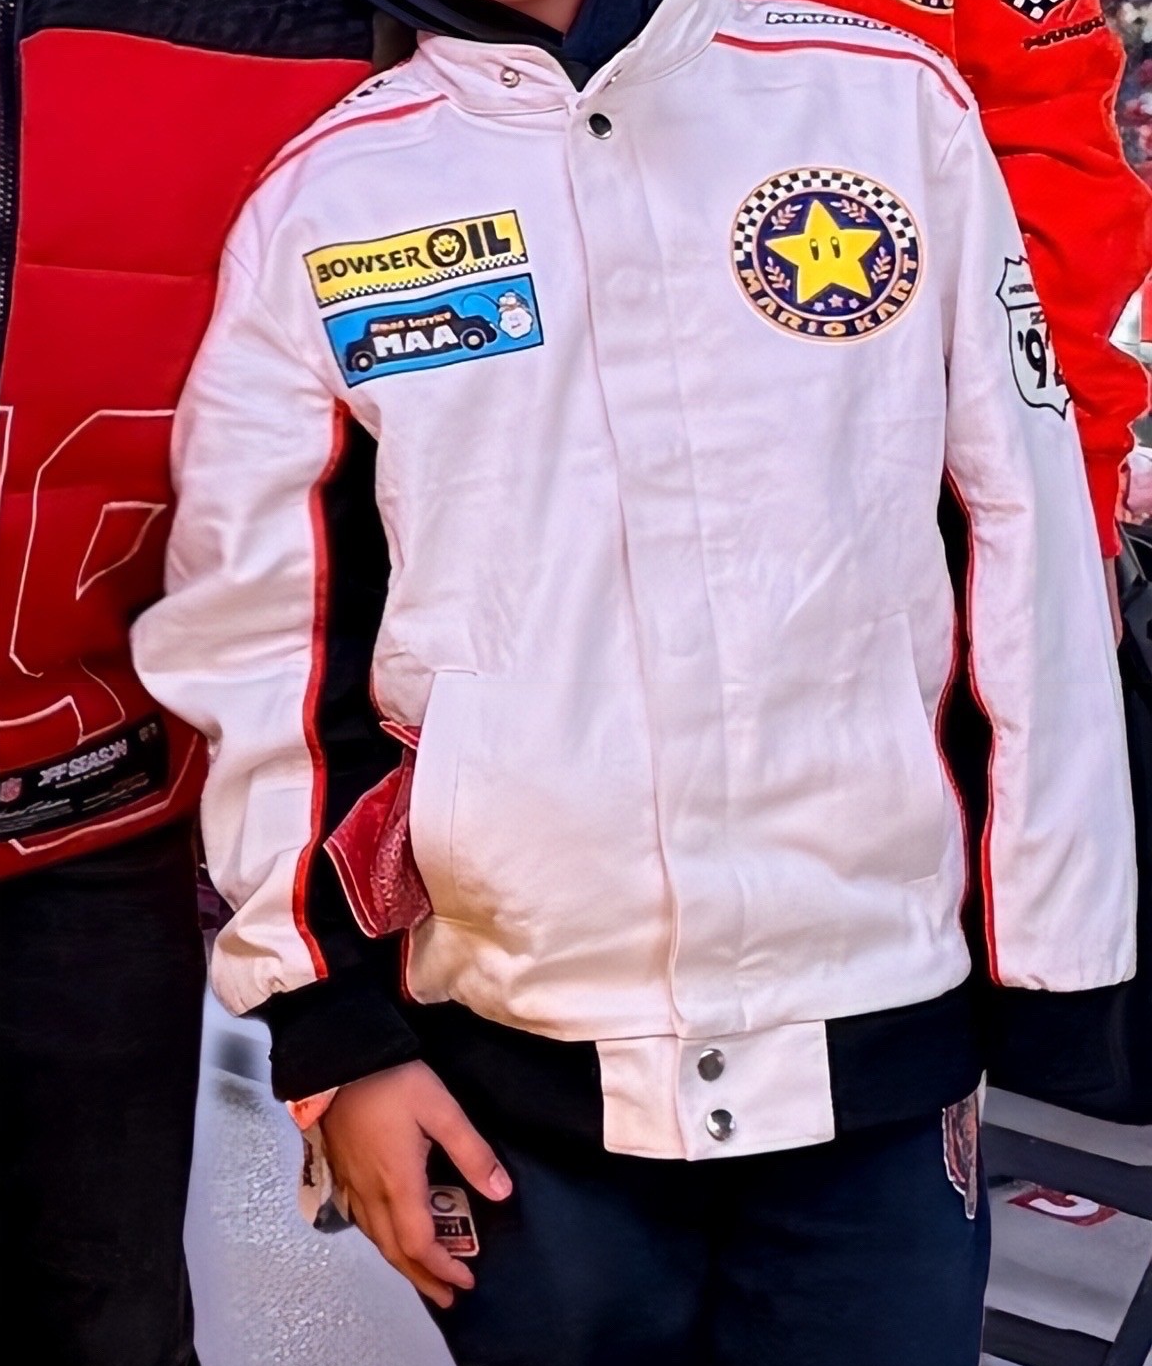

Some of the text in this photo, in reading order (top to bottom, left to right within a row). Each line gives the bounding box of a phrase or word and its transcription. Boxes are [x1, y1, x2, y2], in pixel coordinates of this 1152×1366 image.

[316, 220, 512, 284] BOWSER OIL
[740, 253, 917, 336] MARIO KART
[372, 324, 459, 358] MAA
